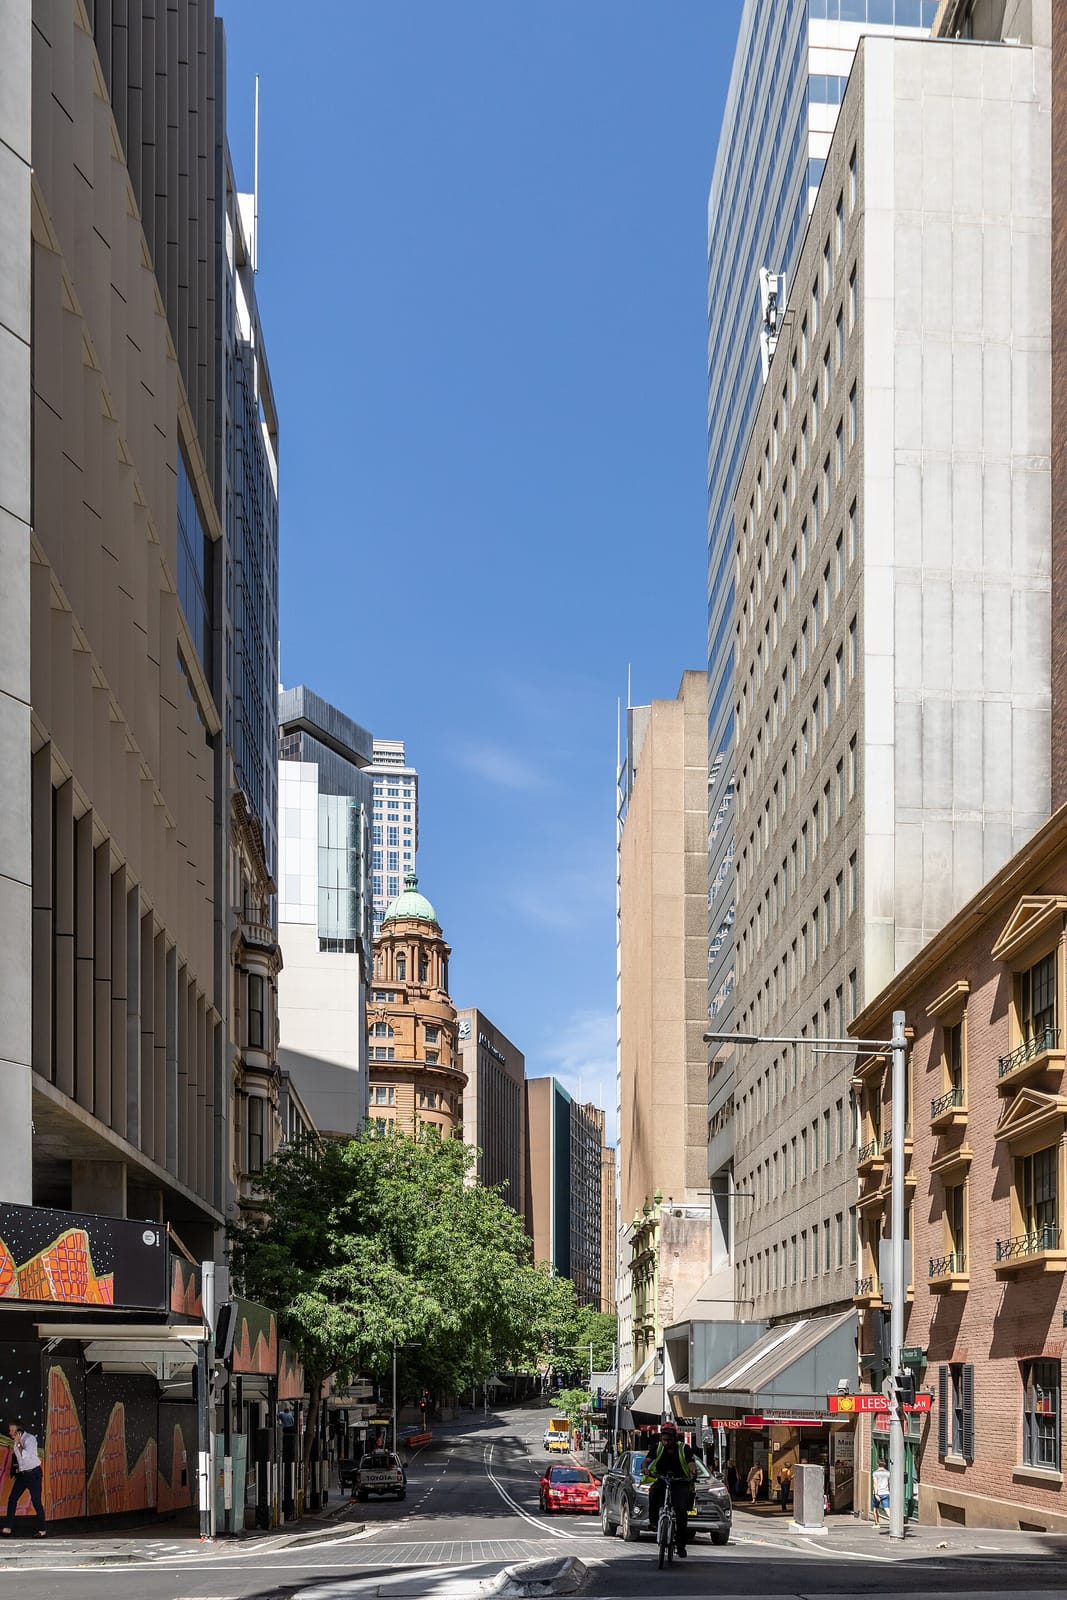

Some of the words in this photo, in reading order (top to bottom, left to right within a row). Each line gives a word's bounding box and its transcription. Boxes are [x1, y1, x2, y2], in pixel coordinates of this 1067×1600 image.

[861, 1398, 887, 1409] LEES
[766, 1409, 790, 1417] Wynyard
[791, 1409, 814, 1417] Blossom
[815, 1411, 839, 1419] Massage
